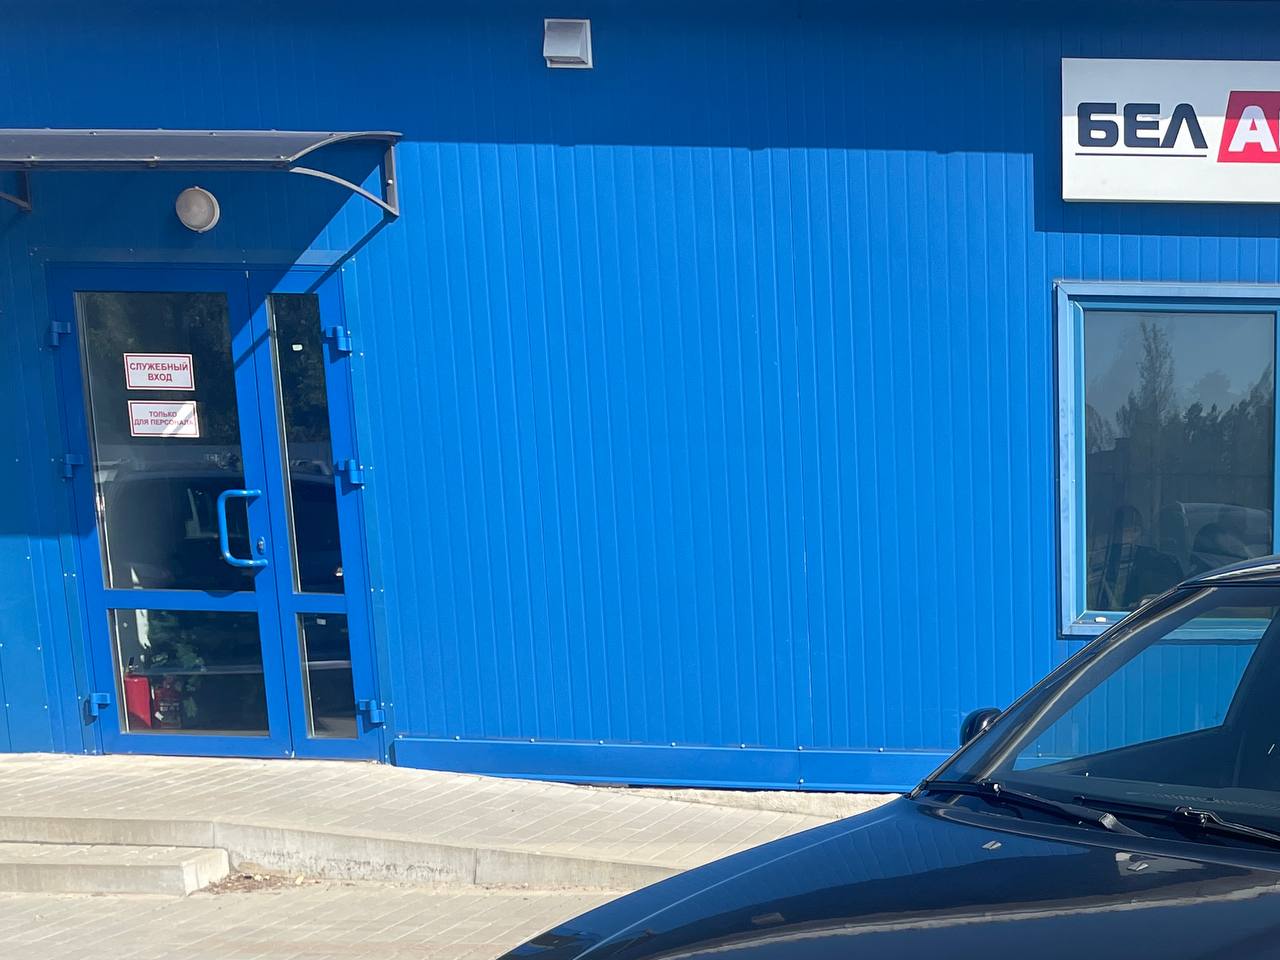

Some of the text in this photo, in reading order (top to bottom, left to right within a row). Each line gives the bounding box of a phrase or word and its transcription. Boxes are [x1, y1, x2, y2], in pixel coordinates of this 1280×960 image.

[1076, 102, 1208, 149] БЕЛ
[129, 361, 189, 371] СЛУЖЕБНЫЙ
[147, 373, 173, 382] ВХОД
